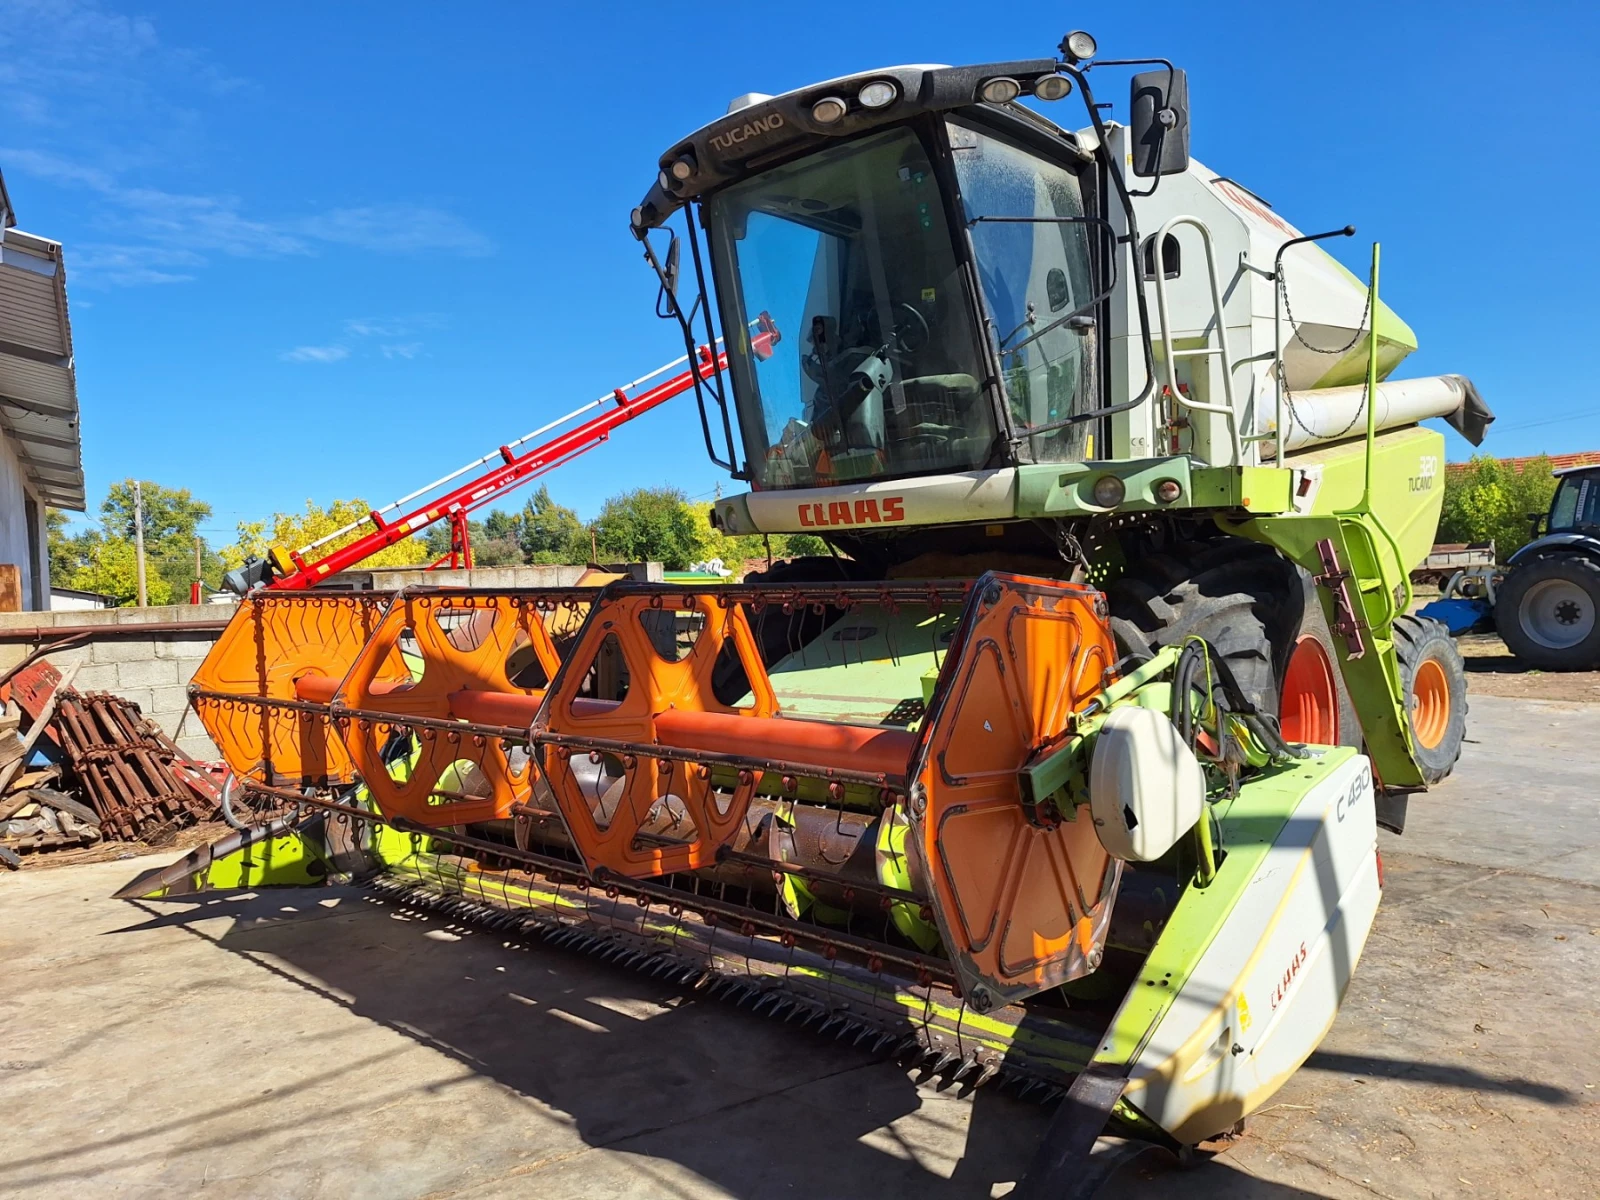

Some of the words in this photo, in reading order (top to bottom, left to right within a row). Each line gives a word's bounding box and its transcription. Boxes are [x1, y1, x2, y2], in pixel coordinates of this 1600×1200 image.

[709, 113, 784, 151] TUCANO
[1419, 456, 1437, 477] 320
[1408, 476, 1432, 493] TUCANO
[798, 497, 905, 527] CLAAS
[1337, 795, 1346, 823] C
[1348, 766, 1370, 807] 430
[1271, 940, 1307, 1011] CLAAS
